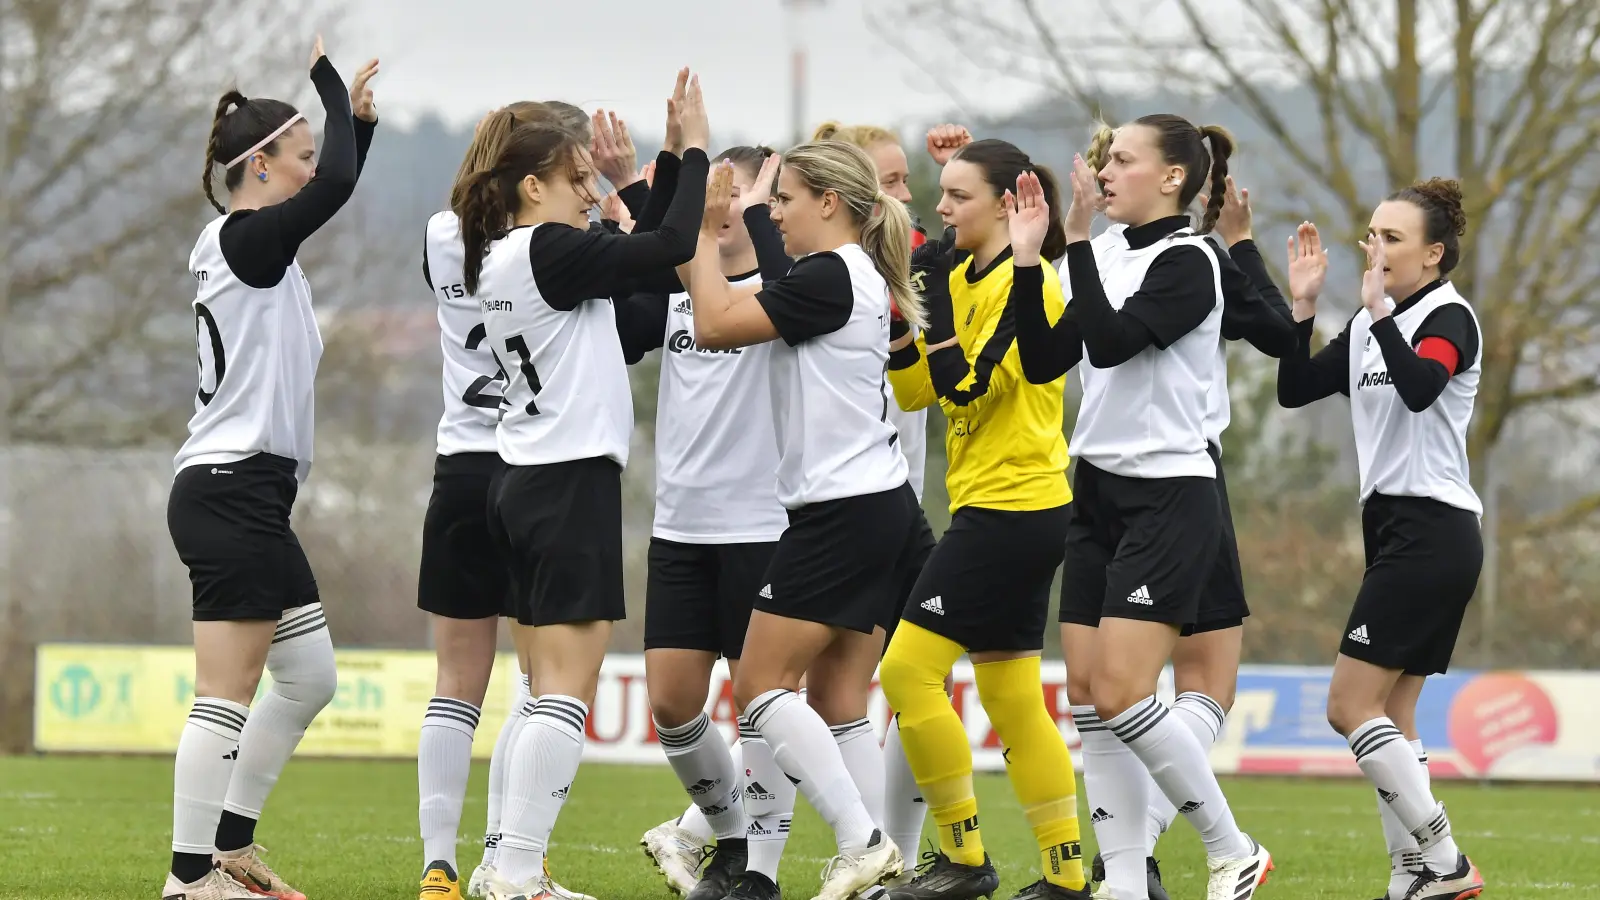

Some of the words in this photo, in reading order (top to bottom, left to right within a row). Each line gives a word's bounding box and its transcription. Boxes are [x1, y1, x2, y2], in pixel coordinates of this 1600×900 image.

[440, 283, 465, 300] TS
[672, 305, 693, 317] adidas
[1126, 595, 1154, 606] adidas
[920, 601, 945, 616] adidas
[1347, 632, 1371, 646] adidas
